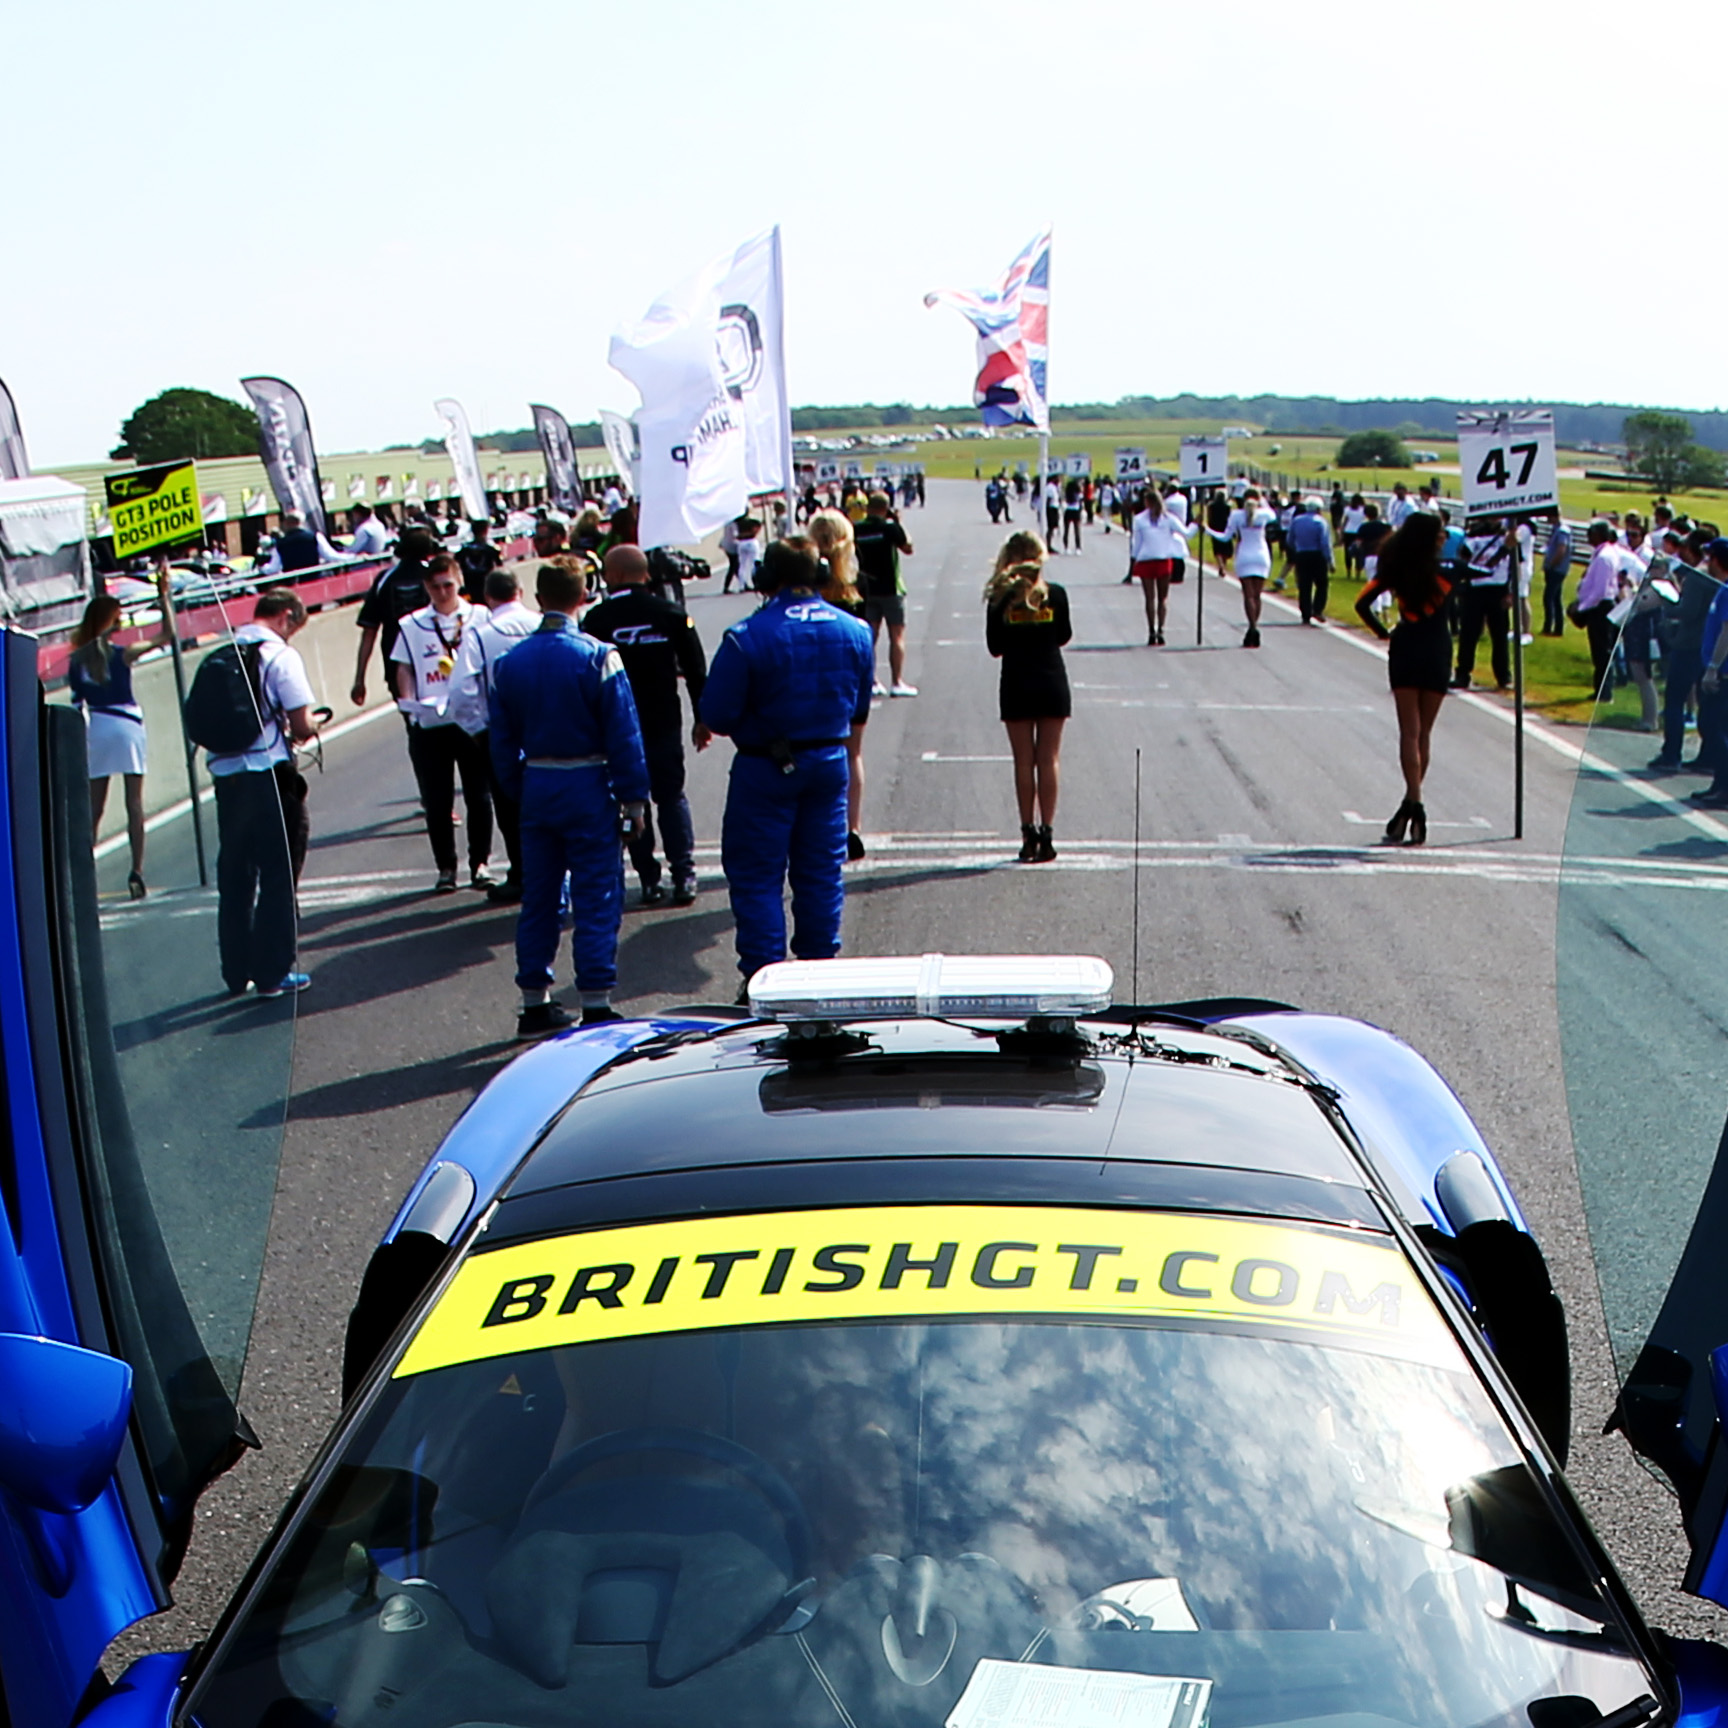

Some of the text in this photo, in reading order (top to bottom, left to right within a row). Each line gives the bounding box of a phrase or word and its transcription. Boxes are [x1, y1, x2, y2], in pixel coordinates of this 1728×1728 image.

[1119, 457, 1141, 474] 24
[1196, 452, 1209, 474] 1
[1476, 441, 1539, 490] 47
[115, 486, 192, 529] GT3 POLE
[118, 508, 195, 549] POSITION
[479, 1241, 1403, 1330] BRITISHGT.COM
